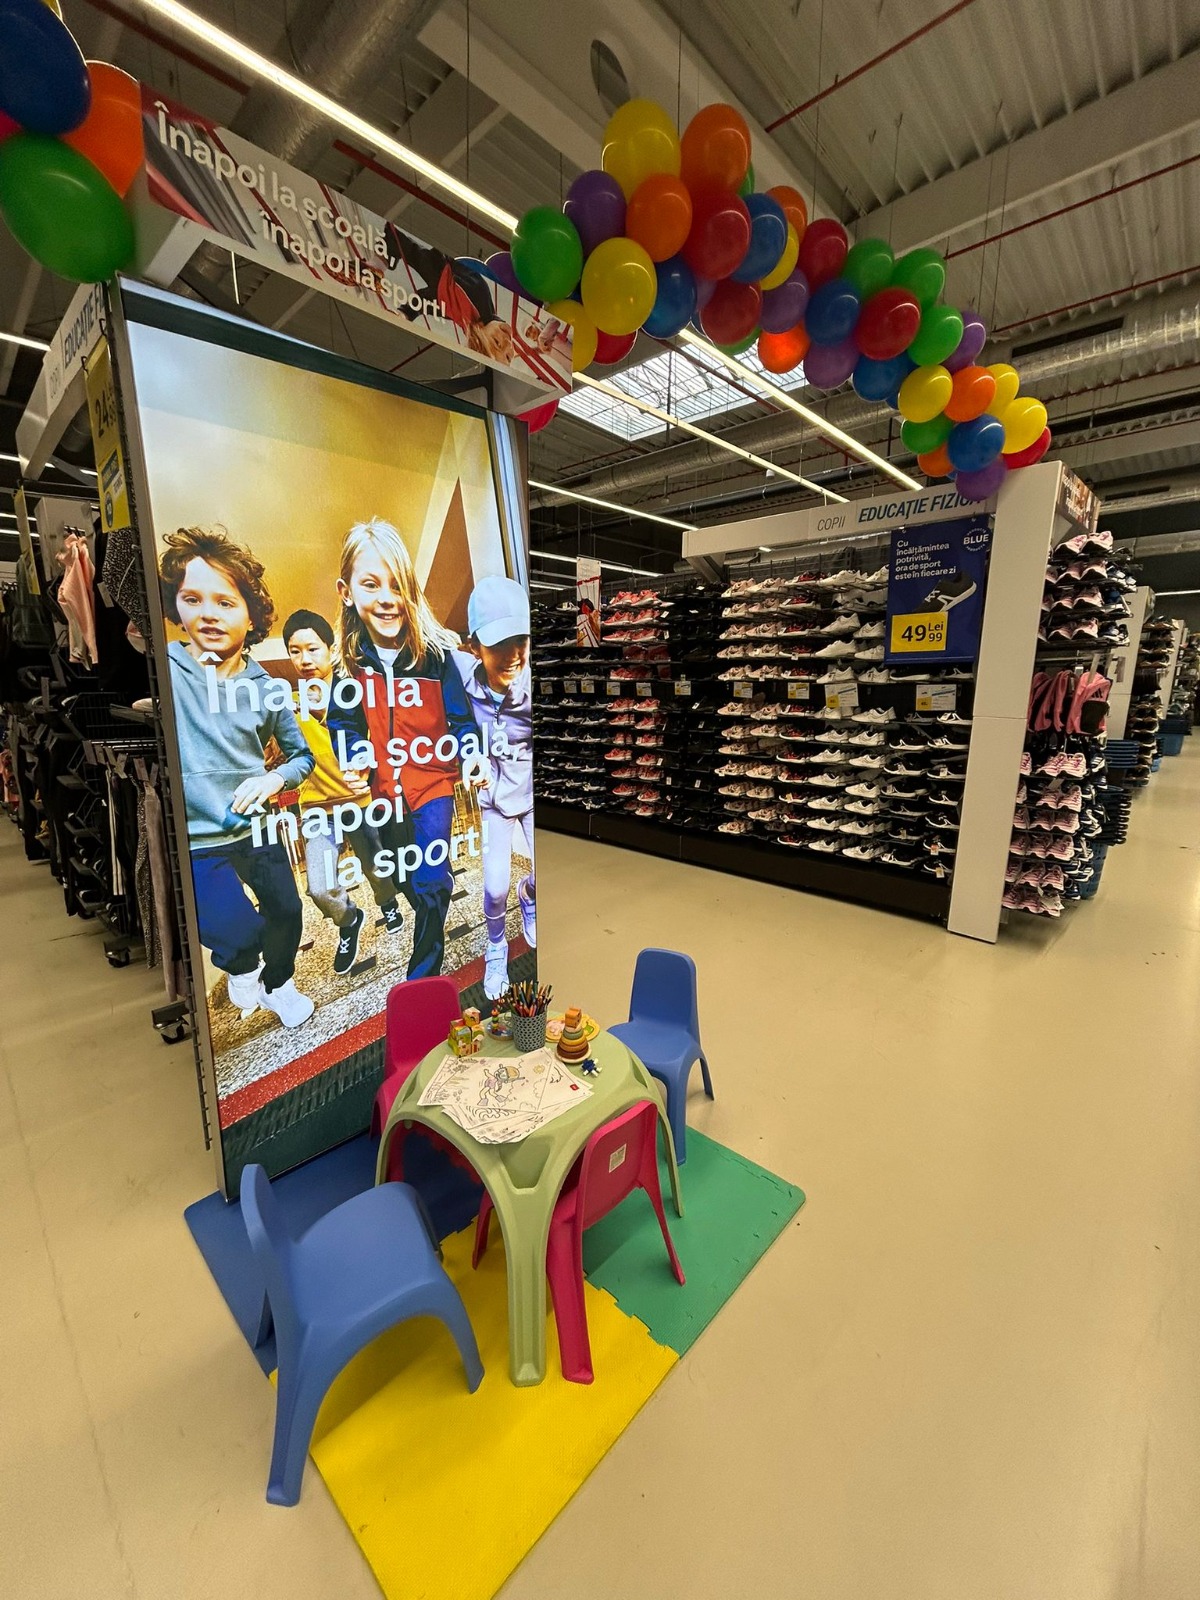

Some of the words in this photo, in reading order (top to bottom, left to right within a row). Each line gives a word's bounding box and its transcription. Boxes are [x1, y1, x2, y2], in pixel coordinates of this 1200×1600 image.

[154, 100, 265, 195] Înapoi
[272, 171, 298, 212] la
[260, 210, 350, 277] înapoi
[354, 258, 377, 291] la
[380, 276, 446, 323] sport!
[817, 515, 846, 531] COPII
[897, 540, 909, 548] Cu
[963, 533, 989, 545] BLUE
[895, 564, 908, 572] ora
[909, 562, 919, 571] de
[919, 560, 941, 571] sport
[895, 571, 912, 580] este
[912, 570, 920, 578] în
[920, 568, 948, 578] fiecare
[948, 565, 957, 574] zi
[901, 624, 927, 643] 49
[928, 620, 944, 632] Lei
[928, 632, 943, 643] 99
[199, 652, 376, 722] Înapoi
[386, 667, 423, 708] la
[337, 729, 378, 771] la
[386, 721, 520, 782] școală,
[246, 785, 404, 848] înapoi
[323, 849, 366, 890] la
[373, 821, 490, 883] sport!
